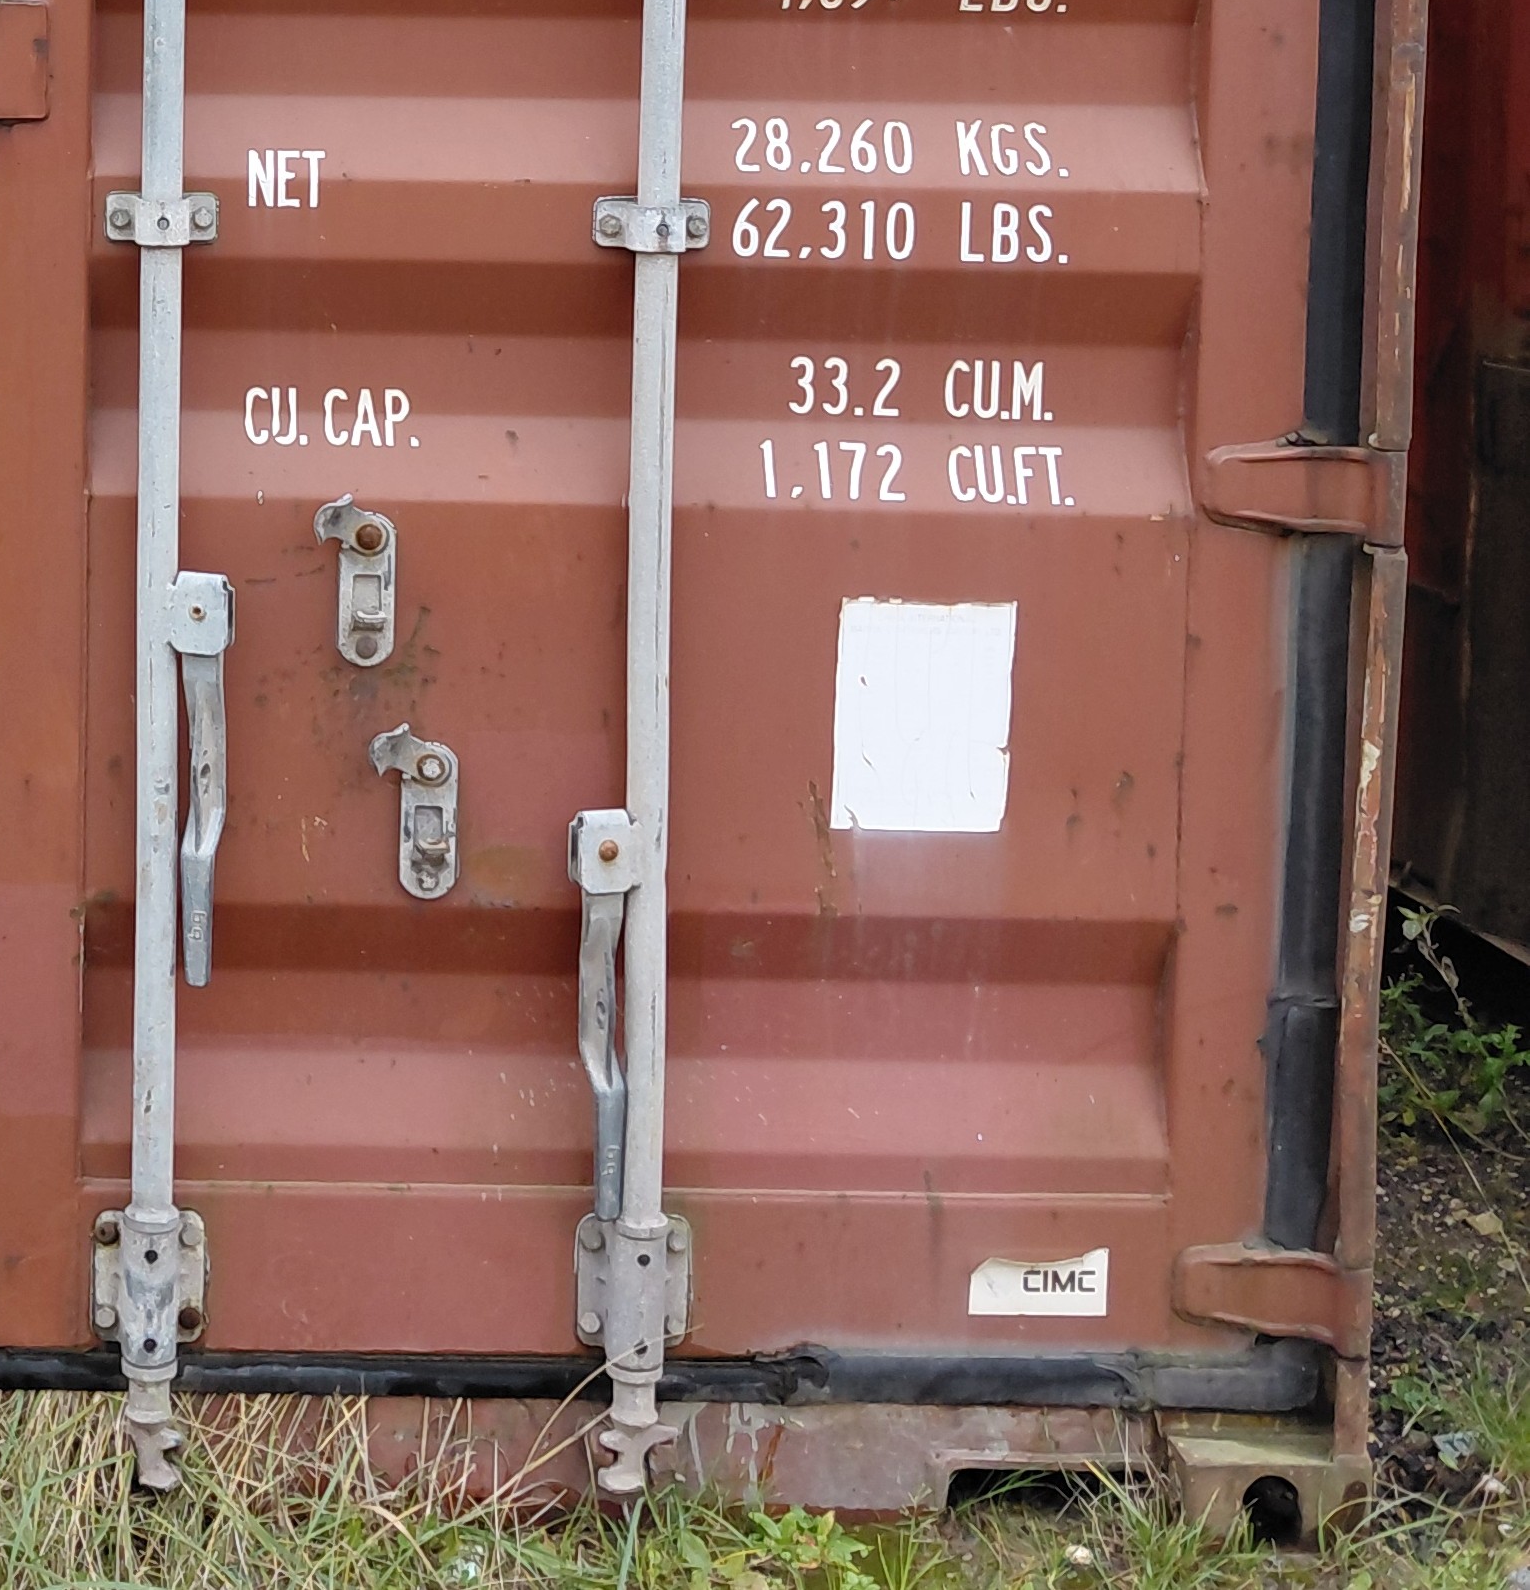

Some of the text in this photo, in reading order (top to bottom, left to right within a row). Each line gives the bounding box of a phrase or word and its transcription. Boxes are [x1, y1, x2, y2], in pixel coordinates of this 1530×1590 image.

[247, 148, 327, 209] NET
[955, 118, 1071, 178] KGS.
[959, 200, 1070, 264] LBS.
[243, 386, 421, 448] CU. CAP.
[787, 355, 1054, 422] 33.2 CU.M.
[947, 444, 1076, 507] CU.FT.
[1022, 1269, 1097, 1293] CIMC
